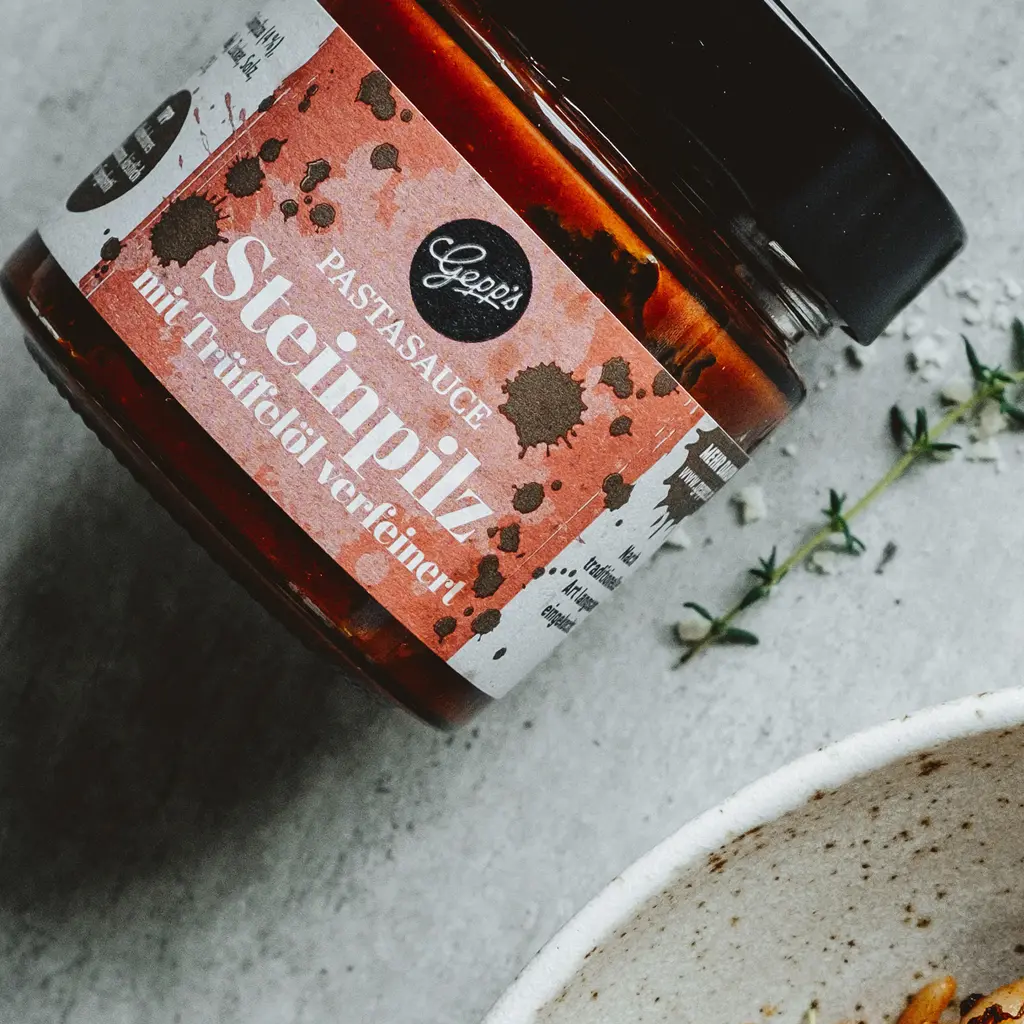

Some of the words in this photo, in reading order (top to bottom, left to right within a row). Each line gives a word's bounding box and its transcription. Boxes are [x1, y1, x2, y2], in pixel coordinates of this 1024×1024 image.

[239, 53, 261, 82] Salz,
[422, 237, 523, 311] Gepp's
[316, 247, 492, 430] PASTASAUCE
[201, 236, 495, 543] Steinpilz
[132, 268, 189, 326] mit
[181, 312, 328, 468] Trüffelöl
[317, 459, 466, 606] verfeinert
[699, 443, 727, 472] MEHR
[561, 579, 582, 599] Art
